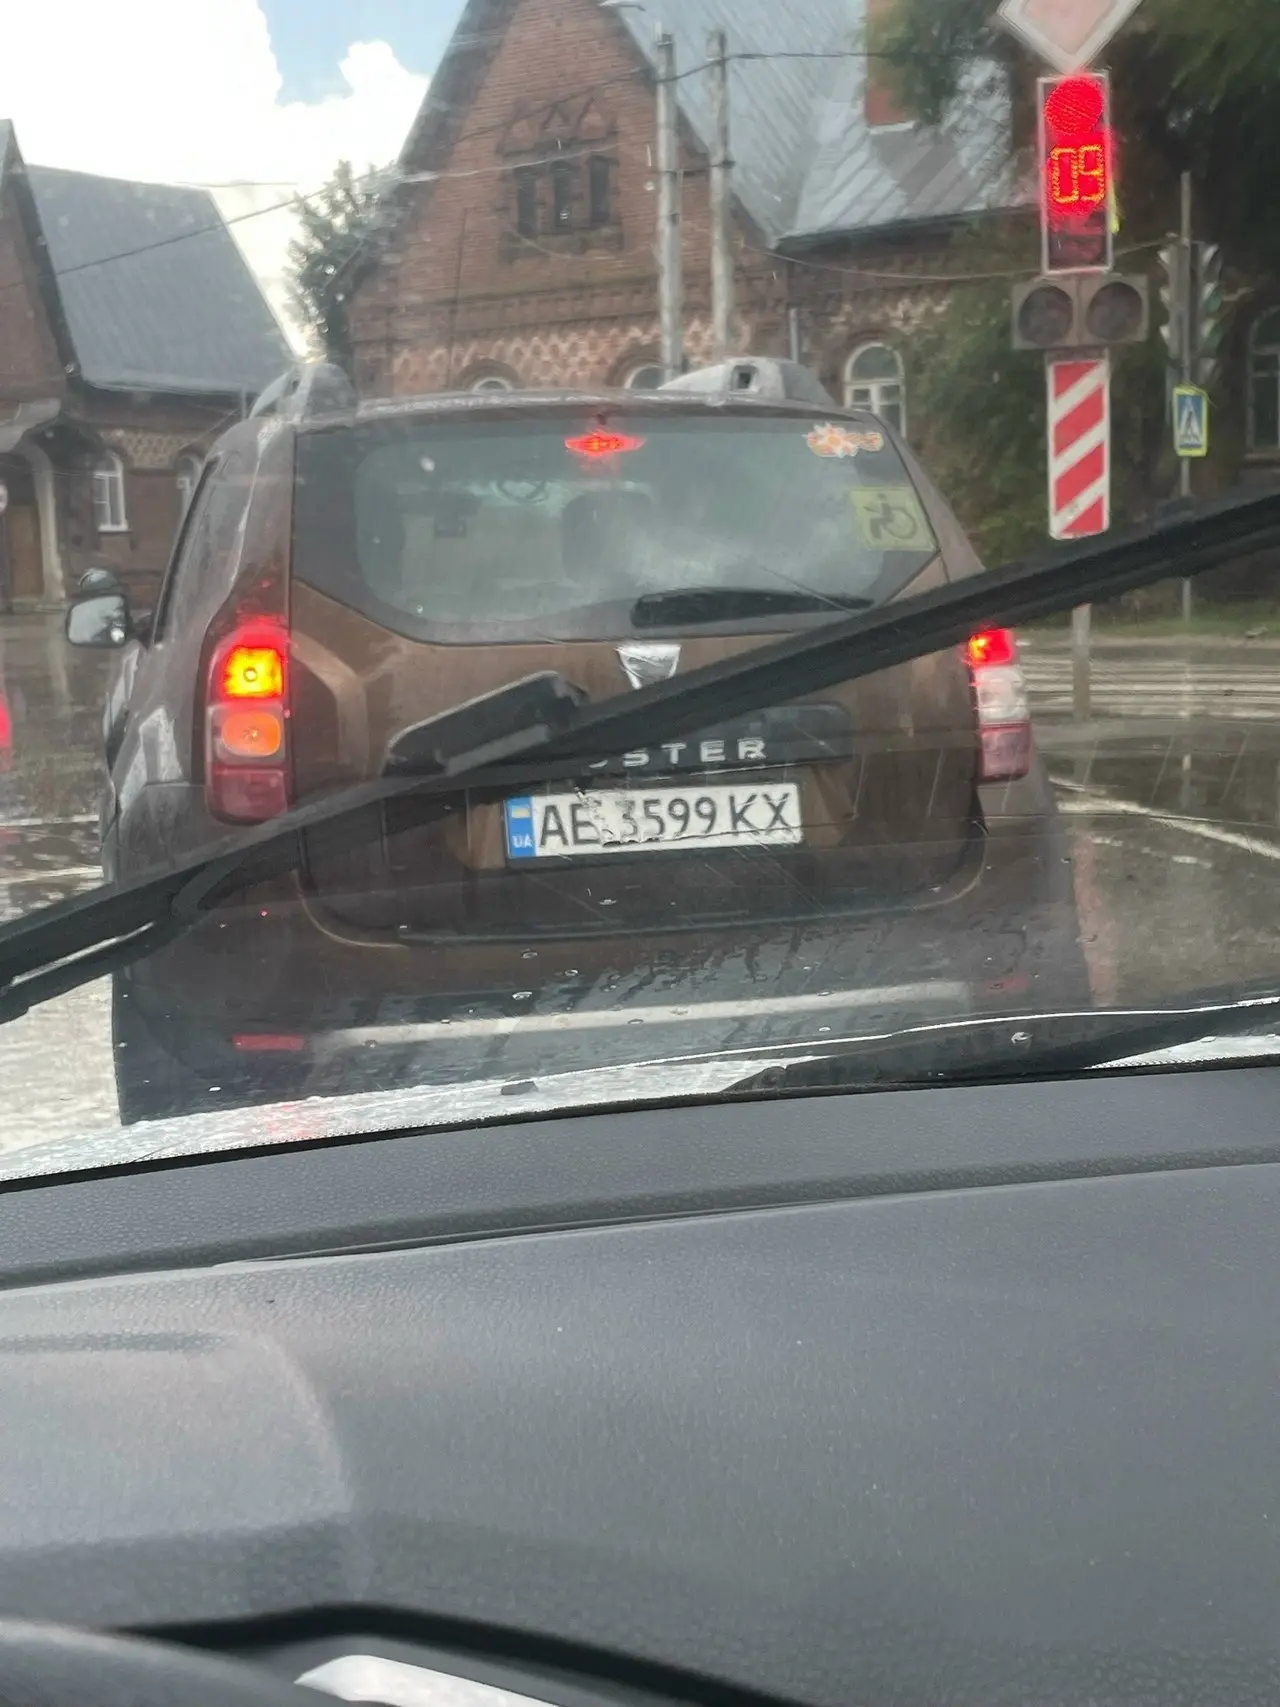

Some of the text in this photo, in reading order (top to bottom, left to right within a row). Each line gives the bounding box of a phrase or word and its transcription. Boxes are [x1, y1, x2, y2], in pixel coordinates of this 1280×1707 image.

[1051, 144, 1105, 203] 09
[589, 737, 767, 768] STER
[512, 834, 533, 848] UA
[539, 791, 794, 848] AE 3599 KX
